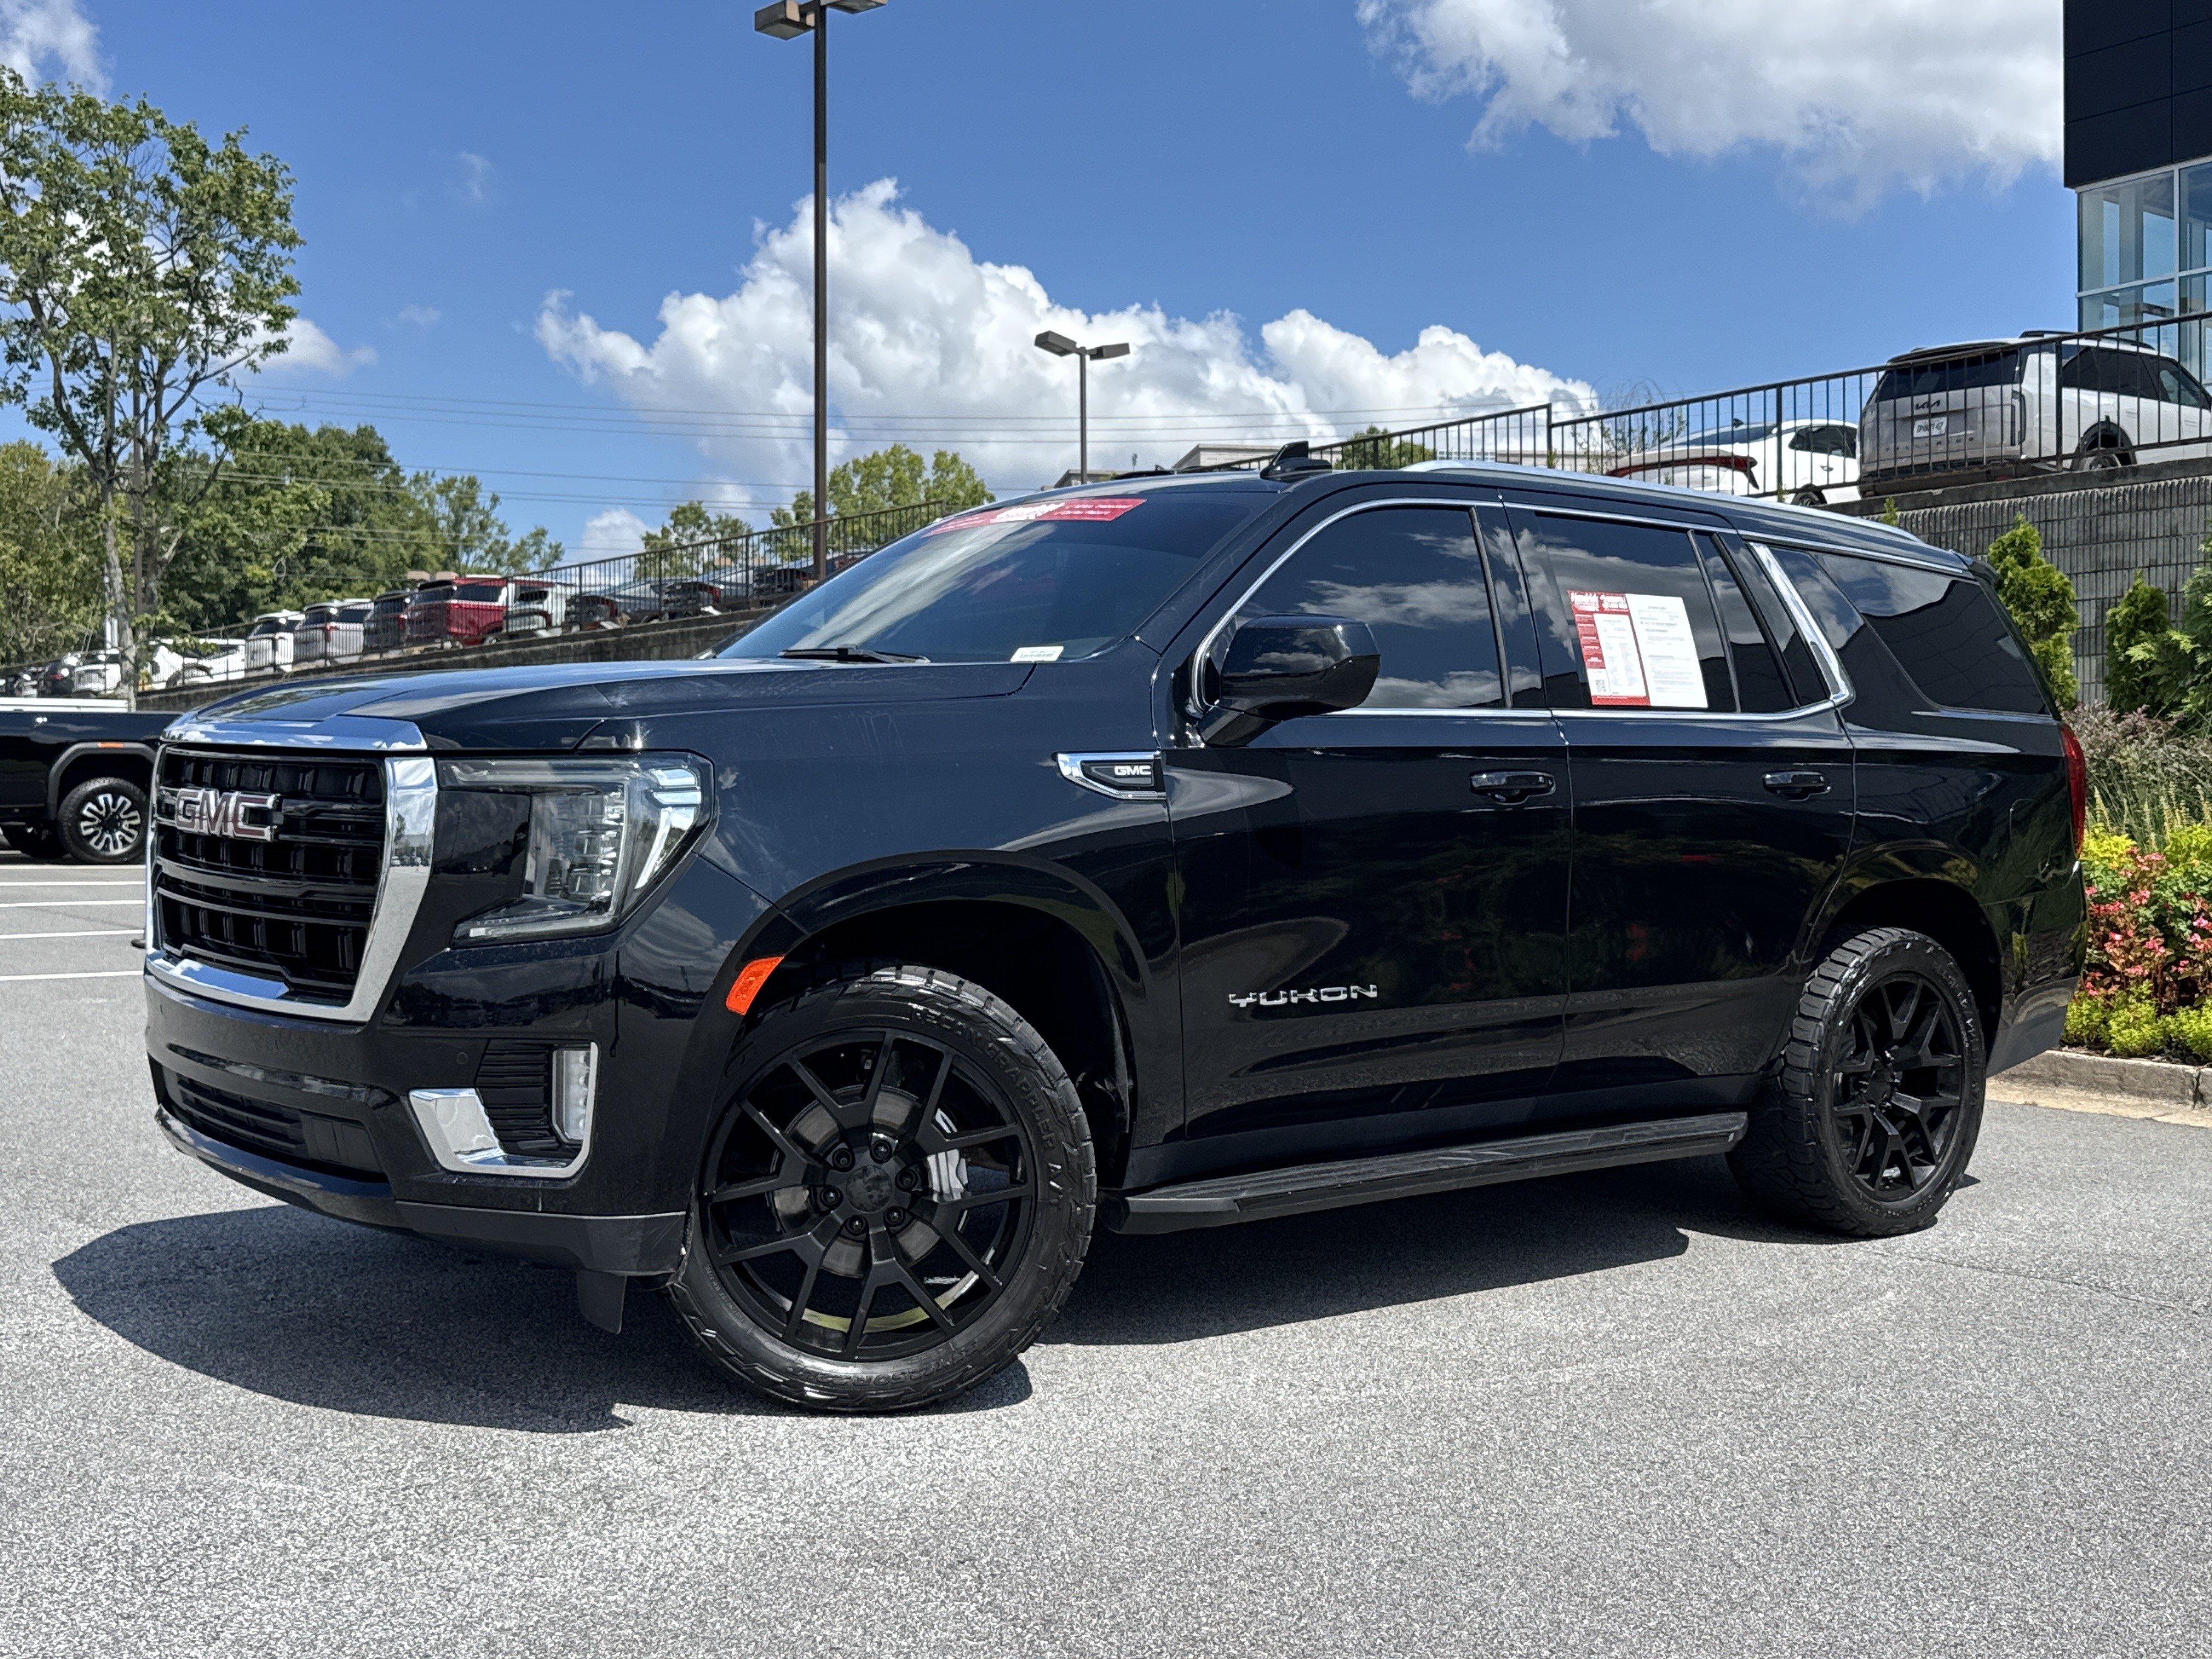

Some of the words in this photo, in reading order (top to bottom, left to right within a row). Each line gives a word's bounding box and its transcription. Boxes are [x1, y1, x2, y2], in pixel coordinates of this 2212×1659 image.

[1114, 765, 1151, 776] GMC
[175, 788, 276, 842] GMC
[1228, 984, 1378, 1008] YUKON
[985, 1043, 1056, 1150] GRAPPLER
